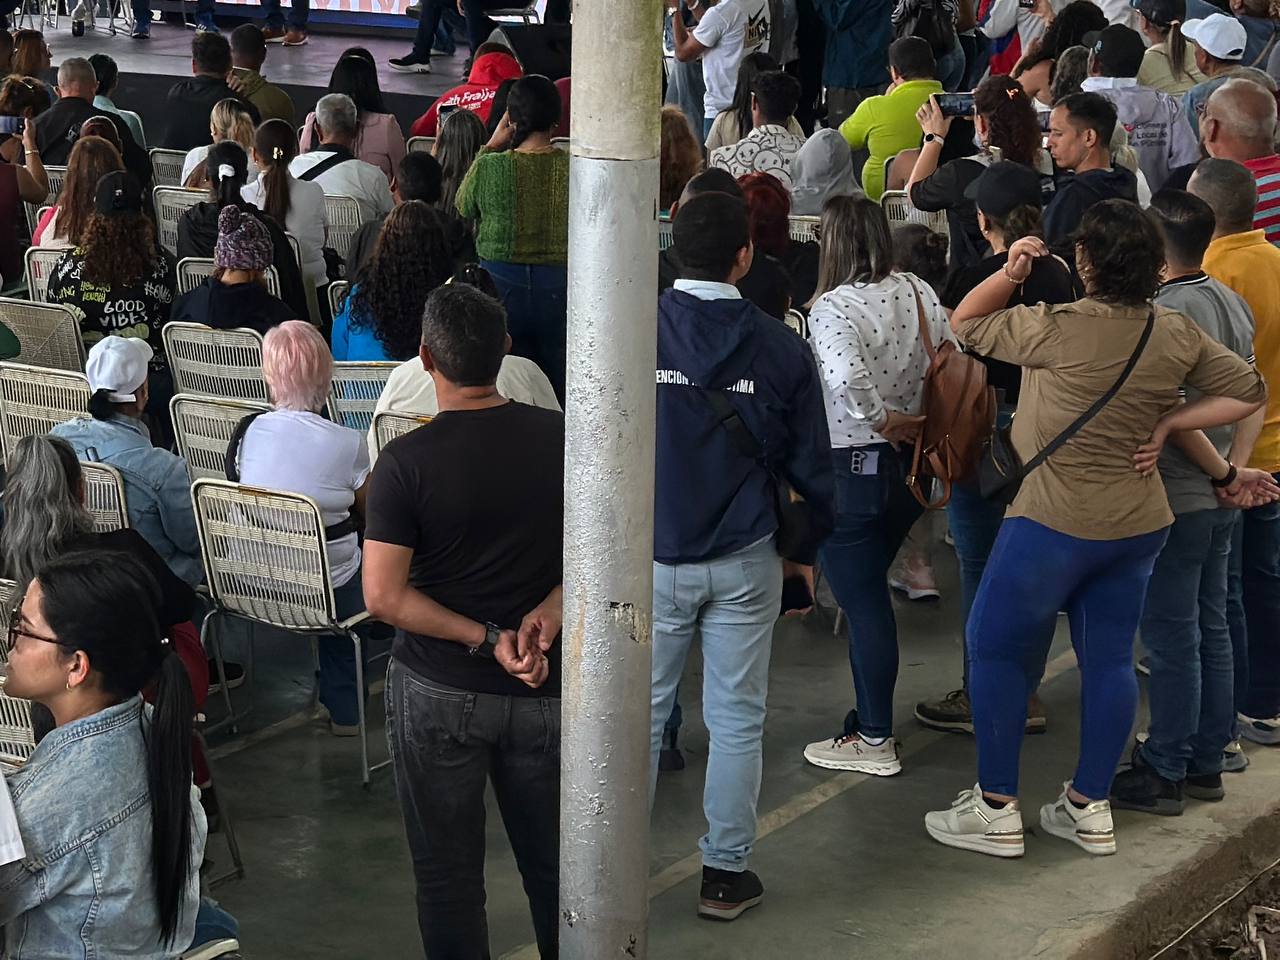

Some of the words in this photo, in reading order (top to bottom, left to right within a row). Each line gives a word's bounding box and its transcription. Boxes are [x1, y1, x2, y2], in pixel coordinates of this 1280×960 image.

[104, 300, 145, 313] GOOD
[99, 310, 148, 327] VIBES
[655, 369, 689, 385] ENCION
